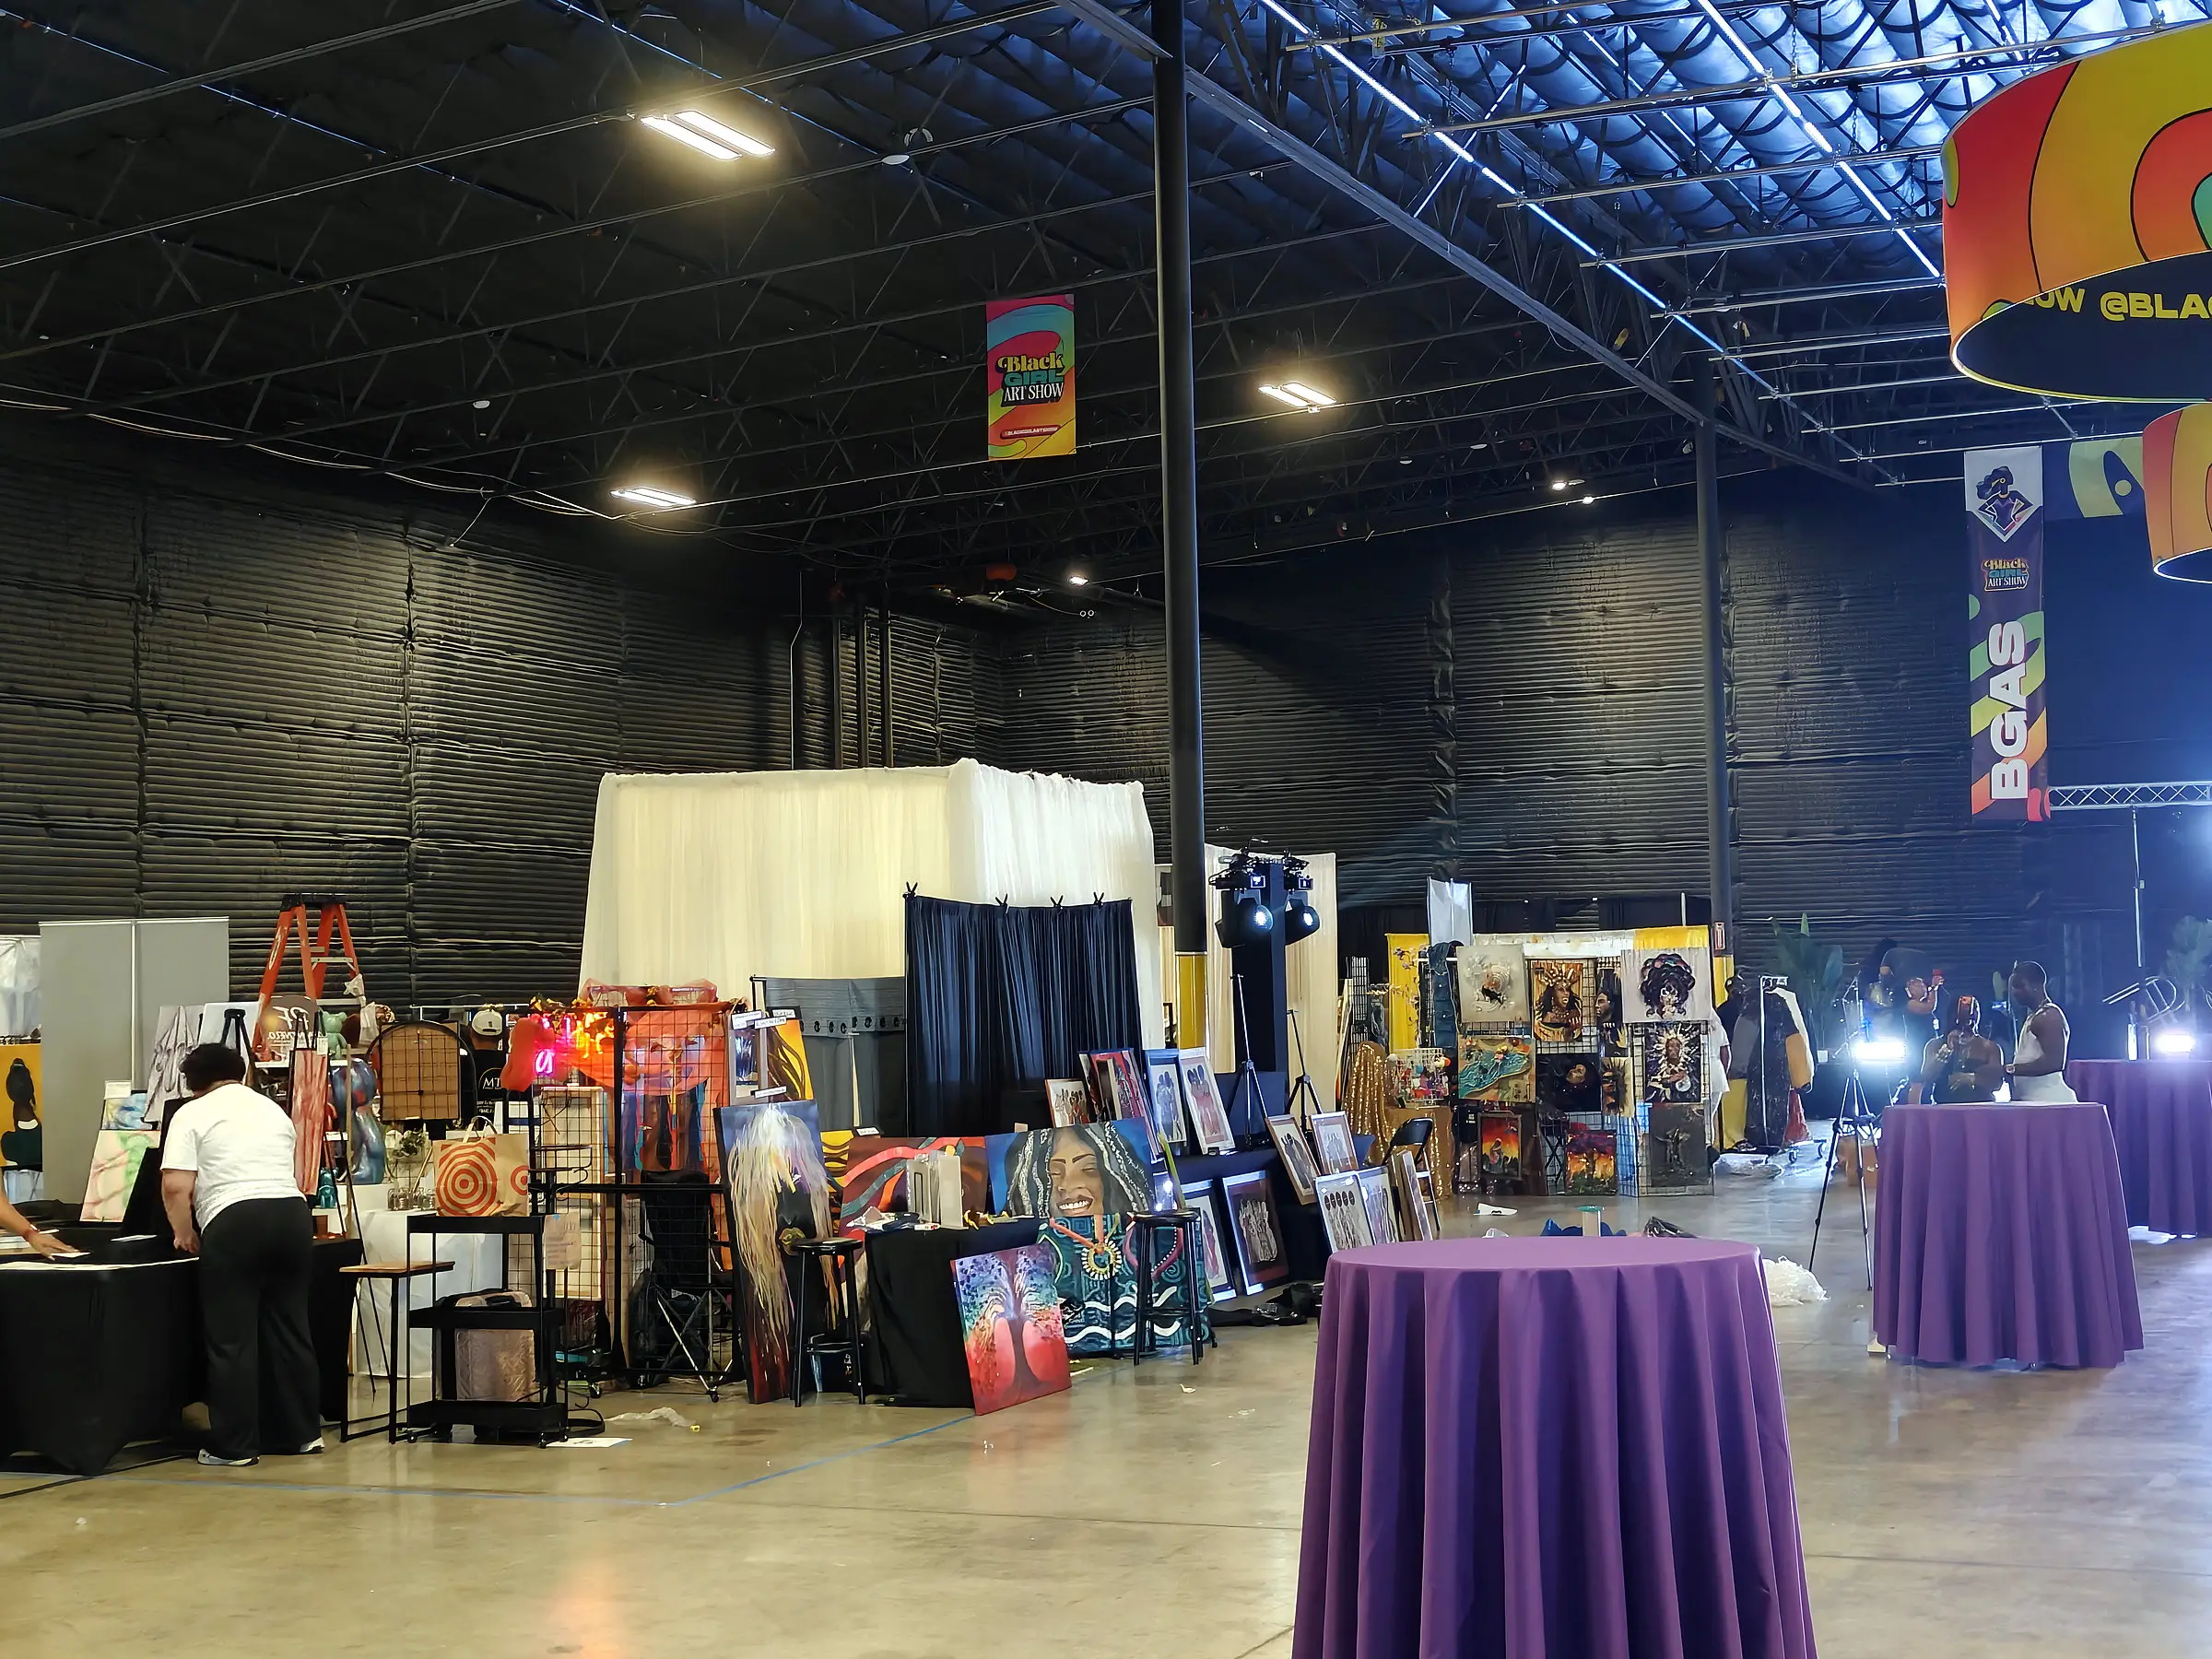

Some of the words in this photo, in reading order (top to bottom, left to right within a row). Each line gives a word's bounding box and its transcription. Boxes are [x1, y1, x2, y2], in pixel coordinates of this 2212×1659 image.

[2100, 291, 2212, 321] @BLA
[997, 352, 1064, 372] Black
[1004, 369, 1064, 386] GIRL
[1004, 385, 1027, 402] ART
[1028, 382, 1064, 400] SHOW
[1988, 577, 2004, 587] ART
[2003, 575, 2027, 586] SHOW
[1988, 619, 2028, 800] BGAS
